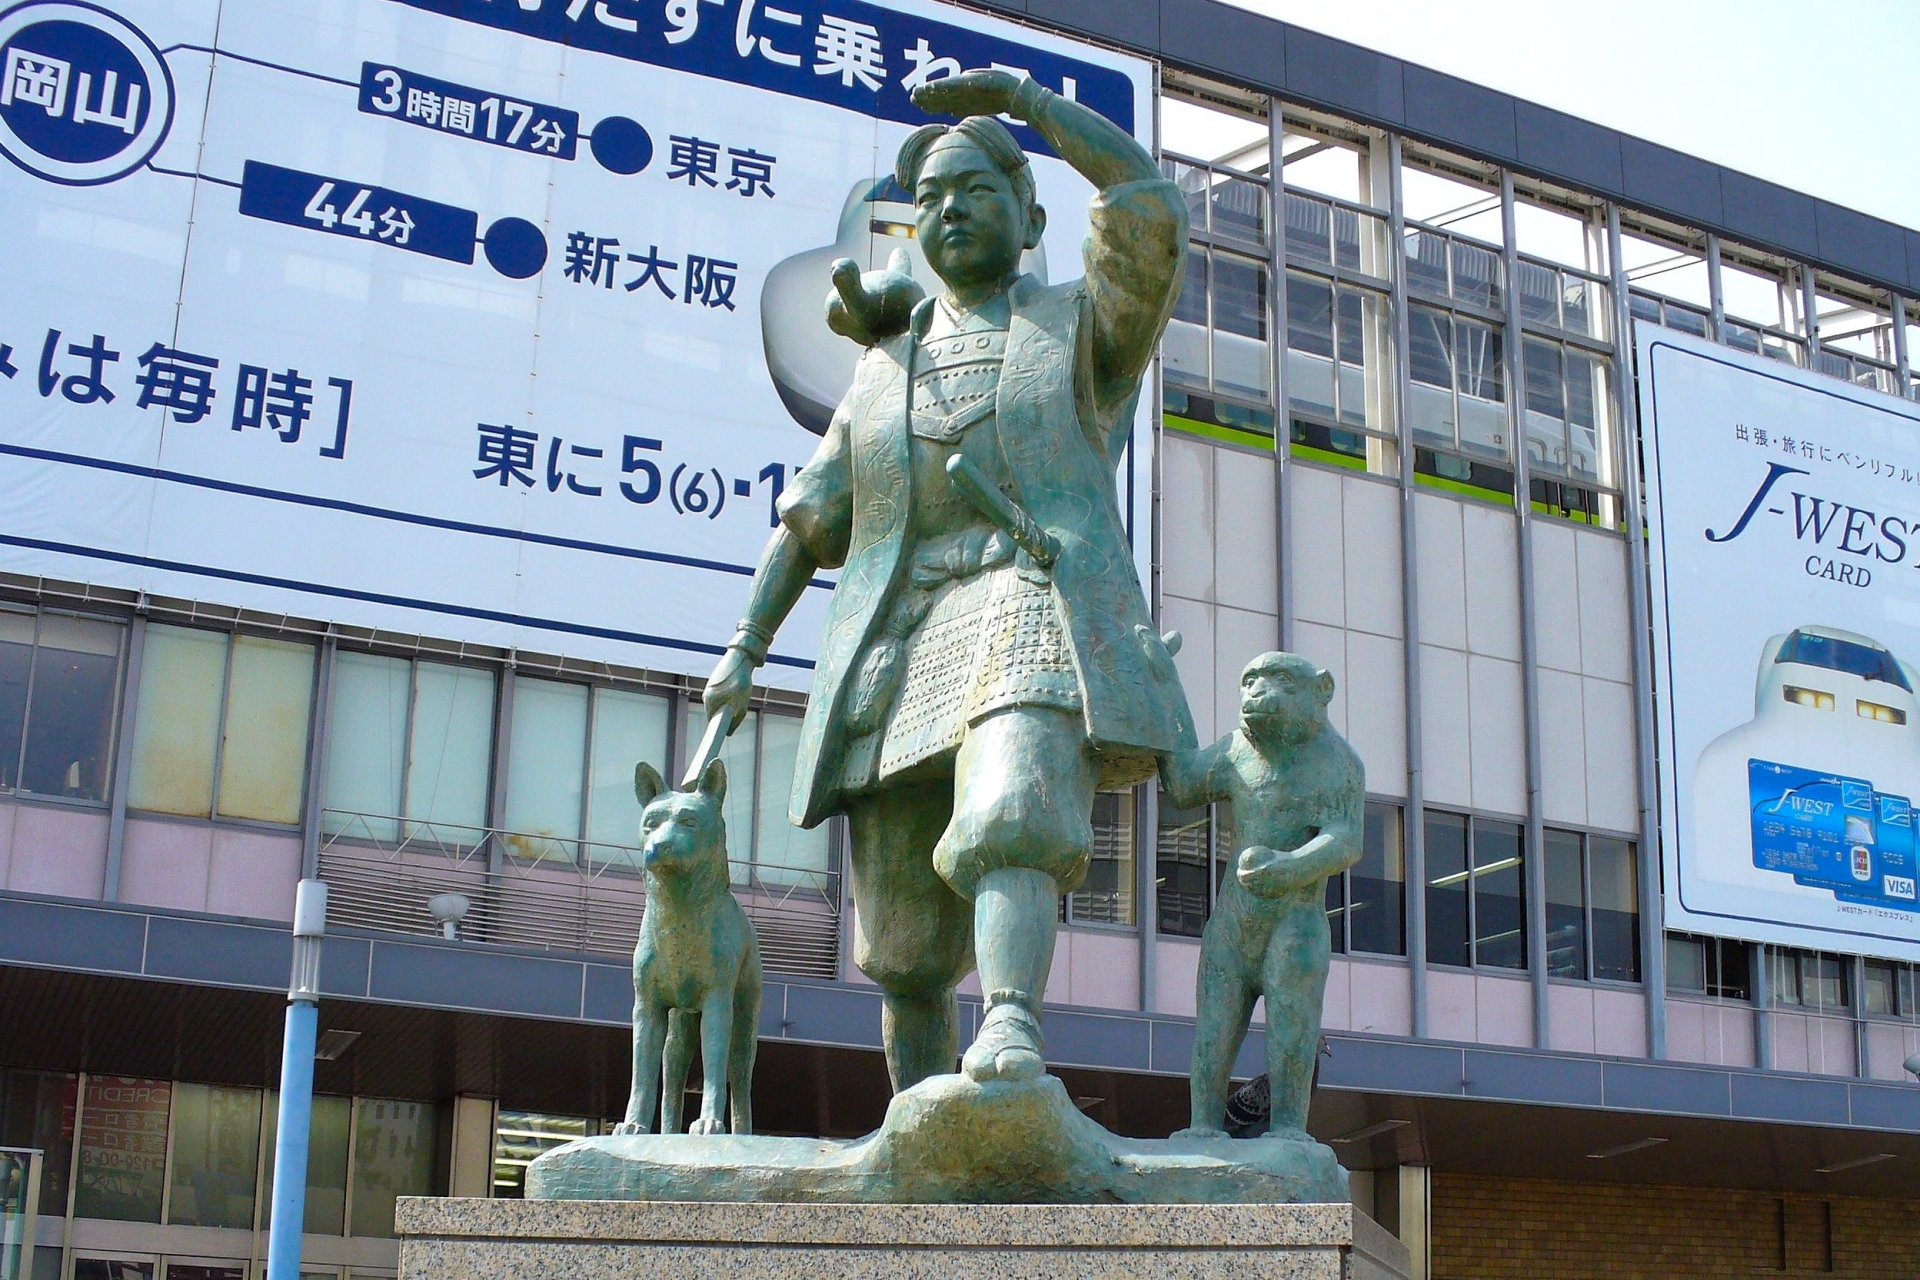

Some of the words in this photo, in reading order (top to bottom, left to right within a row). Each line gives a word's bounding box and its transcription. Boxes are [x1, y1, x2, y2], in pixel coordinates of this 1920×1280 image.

[1, 47, 141, 134] 岡山
[371, 70, 567, 153] 3時間17分
[666, 134, 777, 199] 東京
[304, 182, 416, 245] 44分
[563, 231, 738, 312] 新大阪
[0, 328, 353, 459] は毎時]
[1805, 555, 1872, 588] CARD
[1768, 788, 1834, 816] J-WEST
[1886, 879, 1914, 895] VISA
